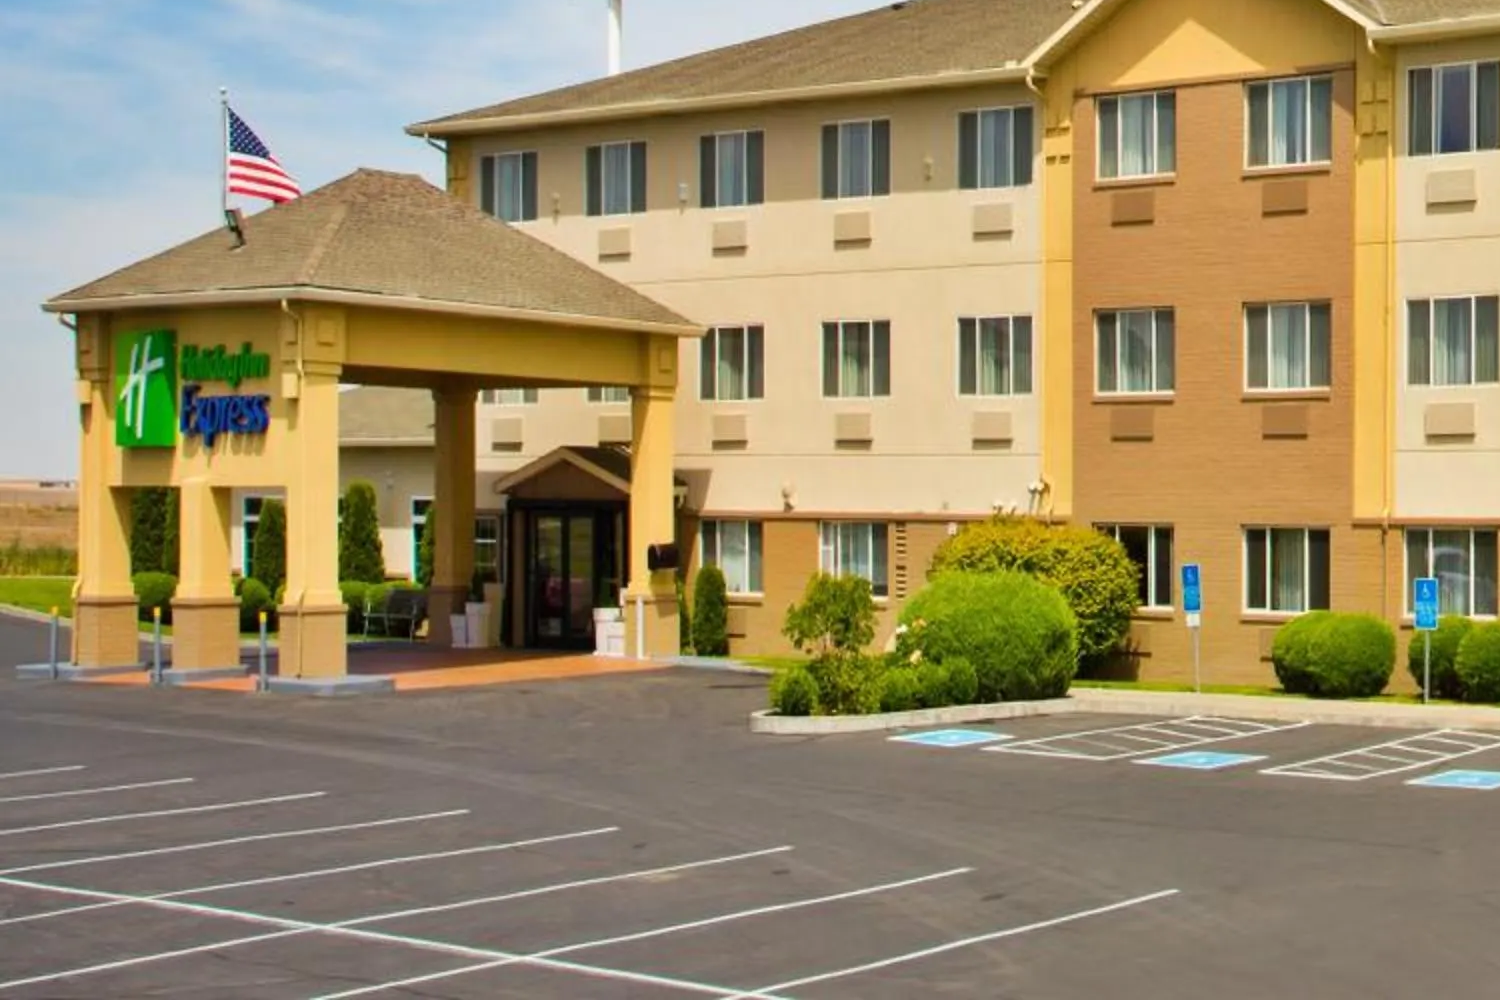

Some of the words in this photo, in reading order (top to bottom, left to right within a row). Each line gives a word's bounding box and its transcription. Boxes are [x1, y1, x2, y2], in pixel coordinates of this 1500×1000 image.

[181, 344, 241, 388] Holiday
[240, 341, 270, 378] Inn
[180, 383, 271, 447] Express
